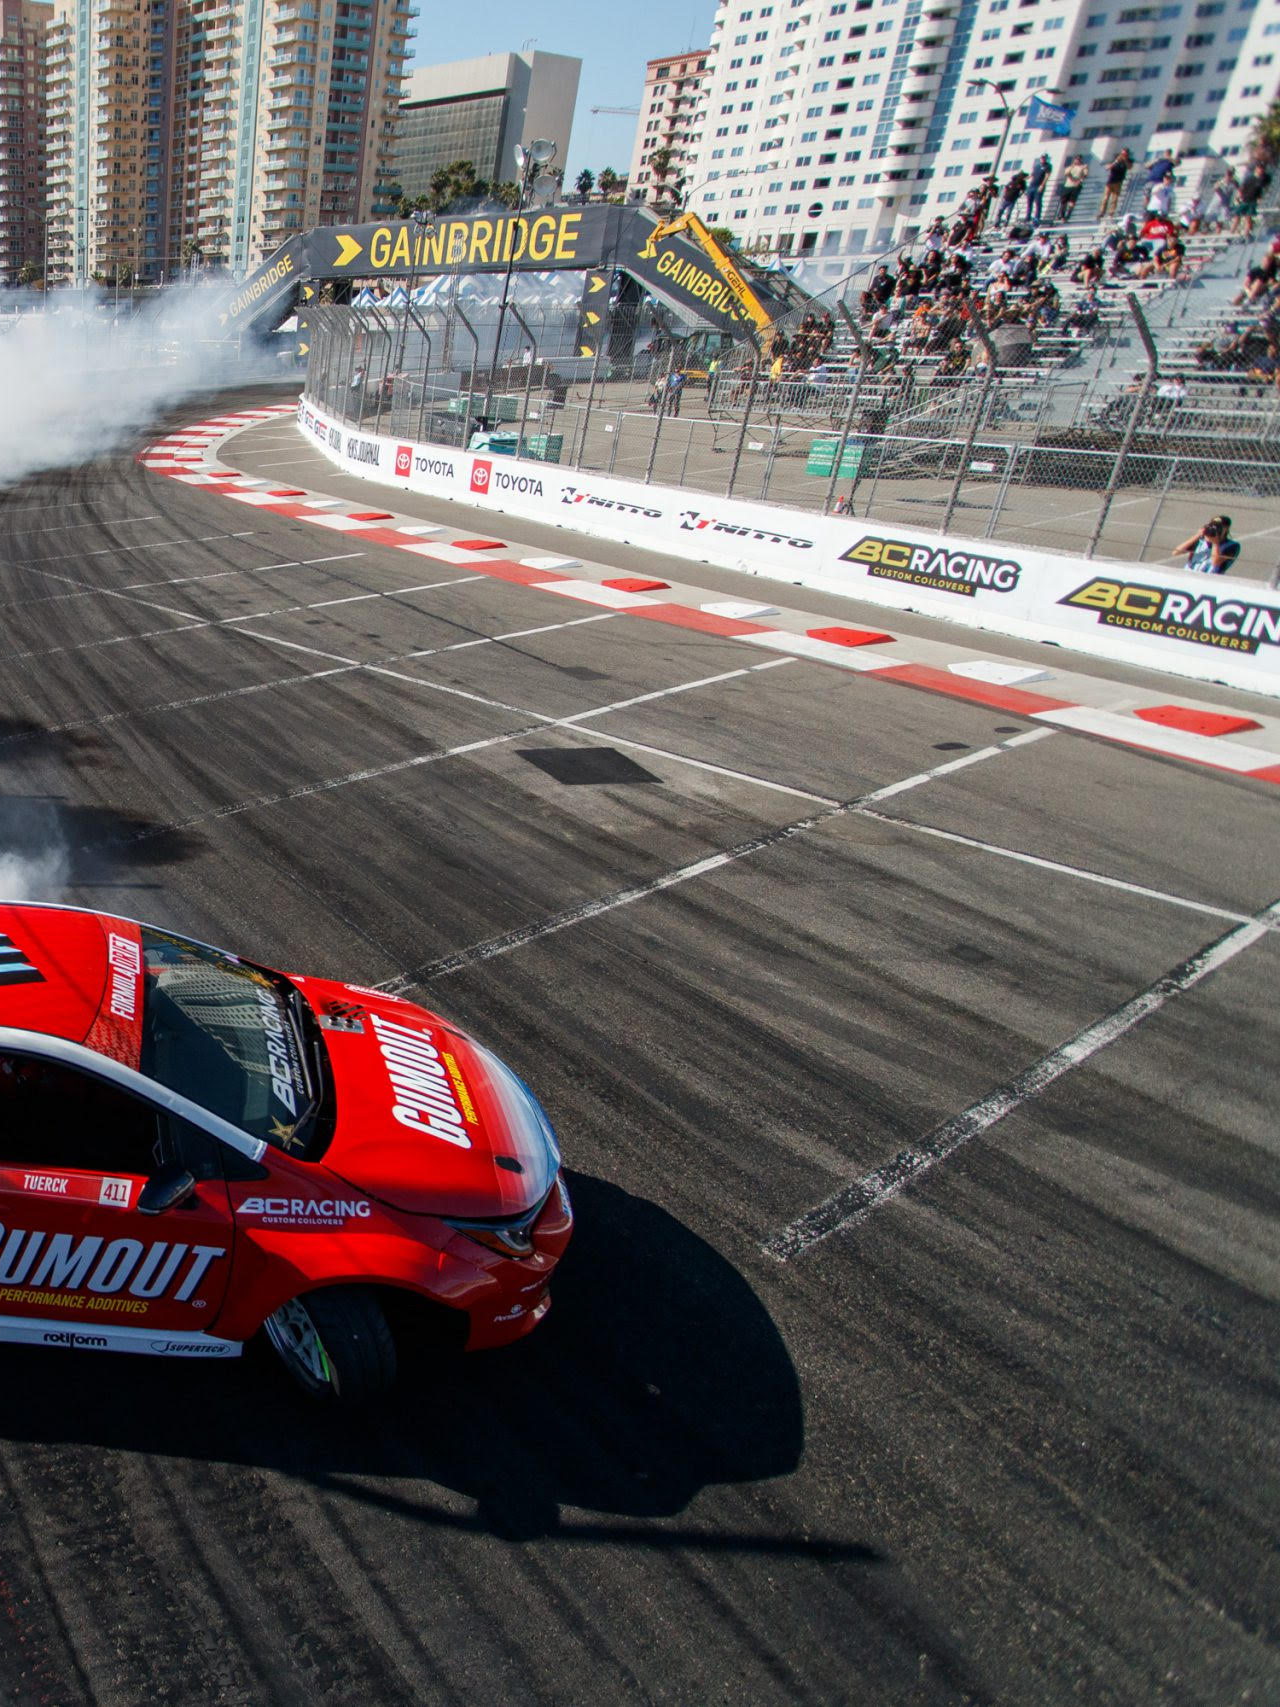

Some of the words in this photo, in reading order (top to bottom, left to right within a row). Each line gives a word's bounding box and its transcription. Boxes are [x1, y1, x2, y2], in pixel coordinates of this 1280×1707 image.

[370, 213, 583, 269] GAINBRIDGE
[229, 254, 294, 318] GAINBRIDGE
[727, 269, 746, 299] GEHL
[415, 457, 454, 478] TOYOTA
[495, 472, 543, 497] TOYOTA
[587, 496, 663, 518] NITTO
[713, 522, 814, 549] NITTO
[873, 567, 913, 581] CUSTOM
[914, 575, 971, 593] COILOVERS
[1159, 593, 1280, 641] RACIN
[1106, 614, 1163, 633] CUSTOM
[1166, 626, 1250, 650] COILOVERS
[109, 933, 140, 974] DRIFT
[110, 966, 136, 1021] FORMULA
[292, 1060, 305, 1096] CUSTOM
[371, 1014, 472, 1150] GUMOUT
[23, 1174, 69, 1194] TUERCK
[103, 1183, 128, 1203] 411
[262, 1216, 296, 1224] CUSTOM
[297, 1217, 344, 1226] COILOVERS
[0, 1288, 86, 1309] PERFORMANCE
[86, 1296, 149, 1314] ADDITIVES
[44, 1331, 108, 1348] rotiform
